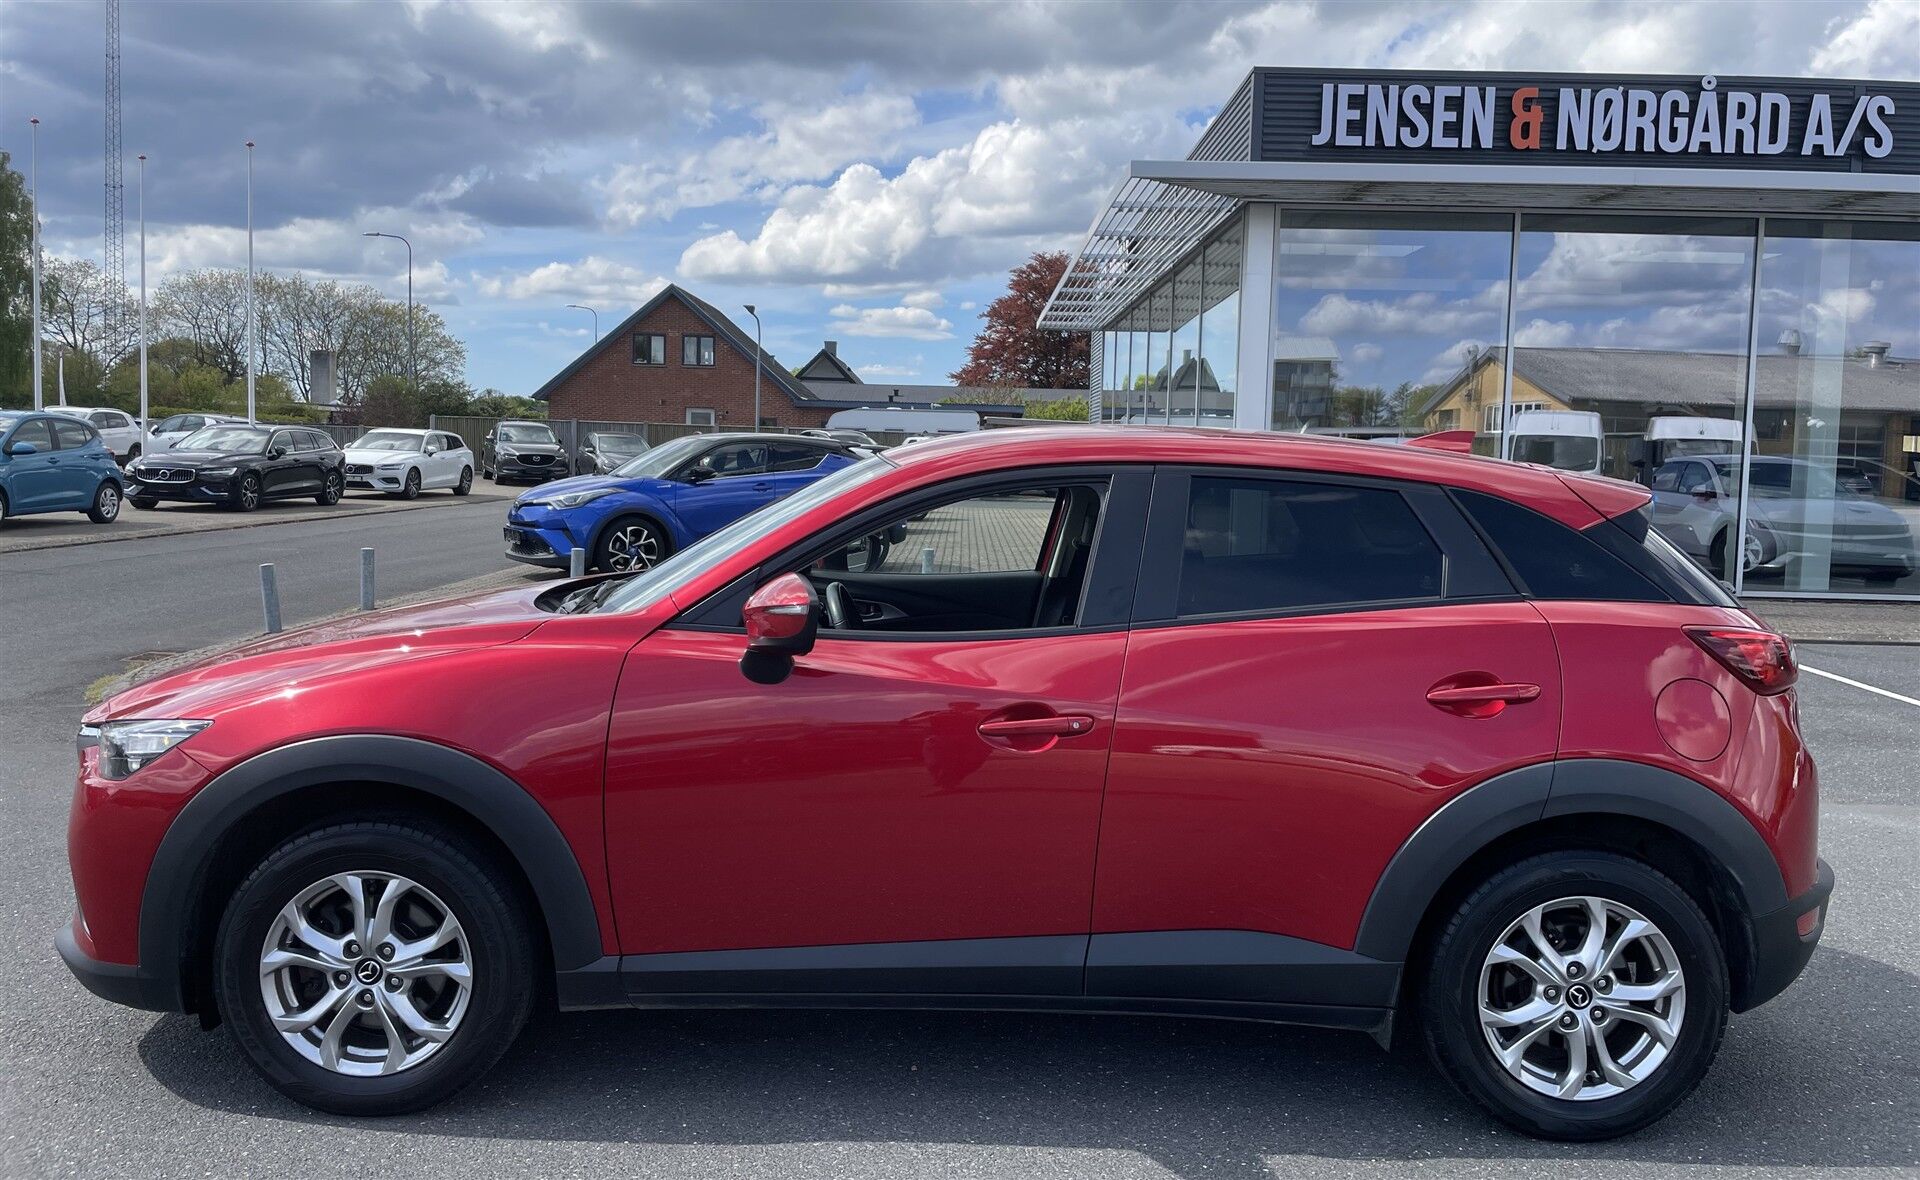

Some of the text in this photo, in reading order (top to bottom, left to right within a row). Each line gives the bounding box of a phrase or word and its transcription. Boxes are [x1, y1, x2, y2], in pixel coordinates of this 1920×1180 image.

[1312, 75, 1897, 159] JENSEN & NØRGÅRD A/S
